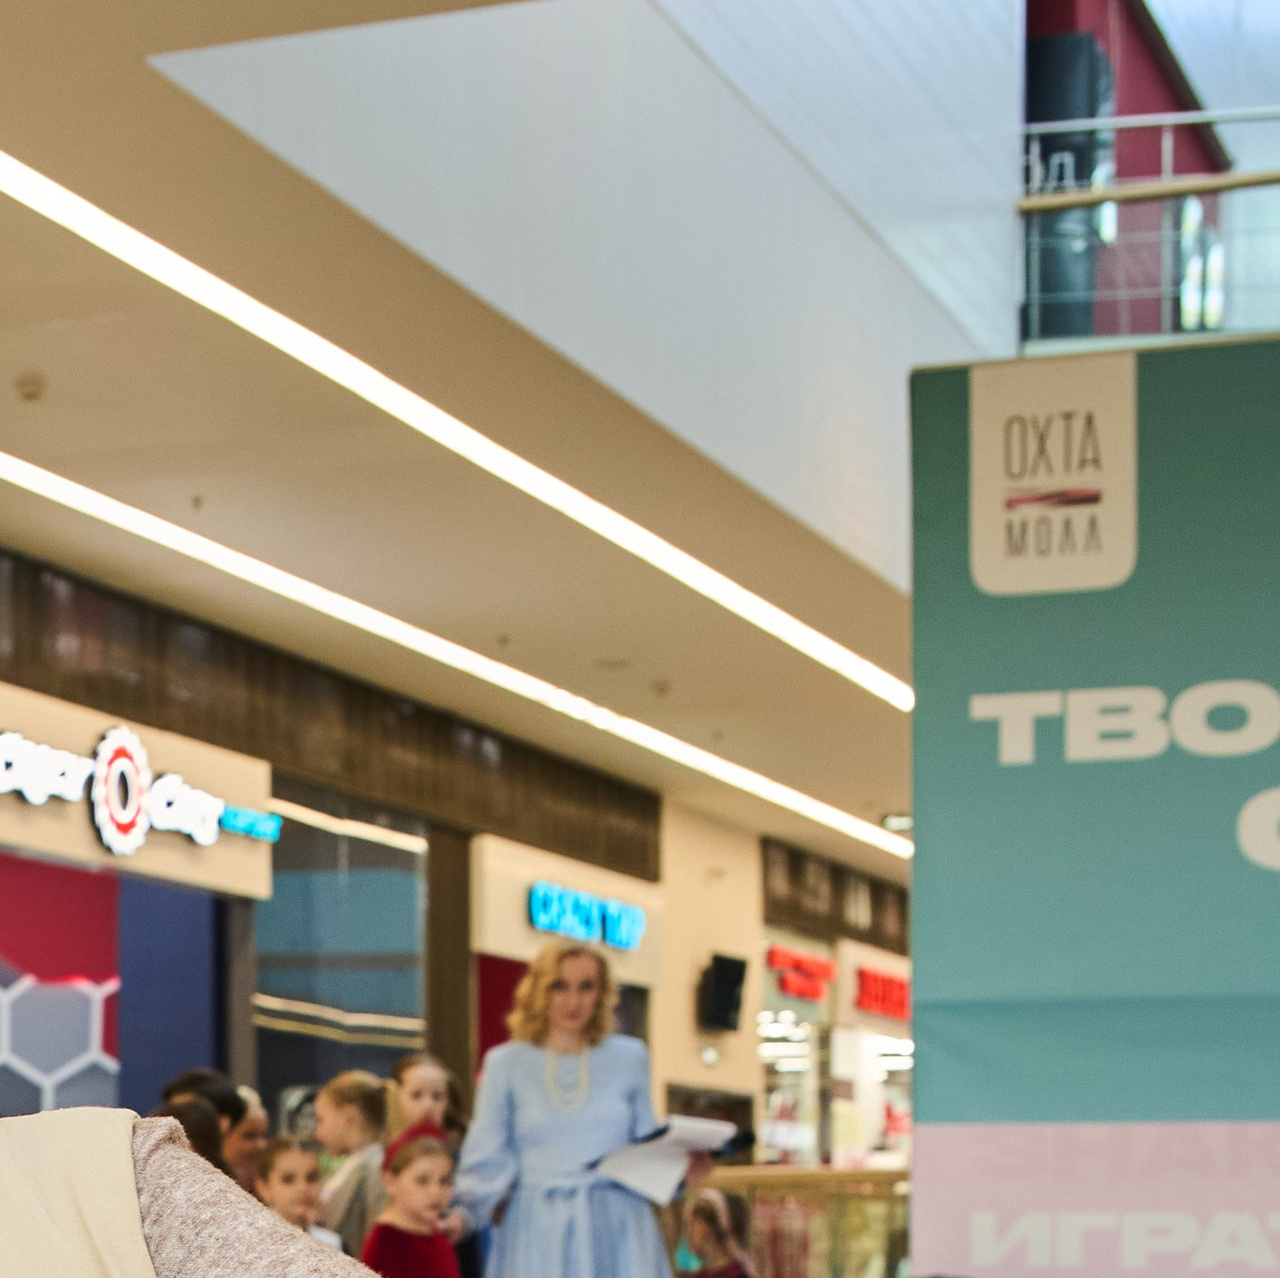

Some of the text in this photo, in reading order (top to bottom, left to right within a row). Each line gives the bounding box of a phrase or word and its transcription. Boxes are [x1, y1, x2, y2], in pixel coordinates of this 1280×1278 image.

[1002, 409, 1104, 482] ОХТА
[969, 678, 1280, 767] ТВО
[970, 1209, 1280, 1270] ИГРА
